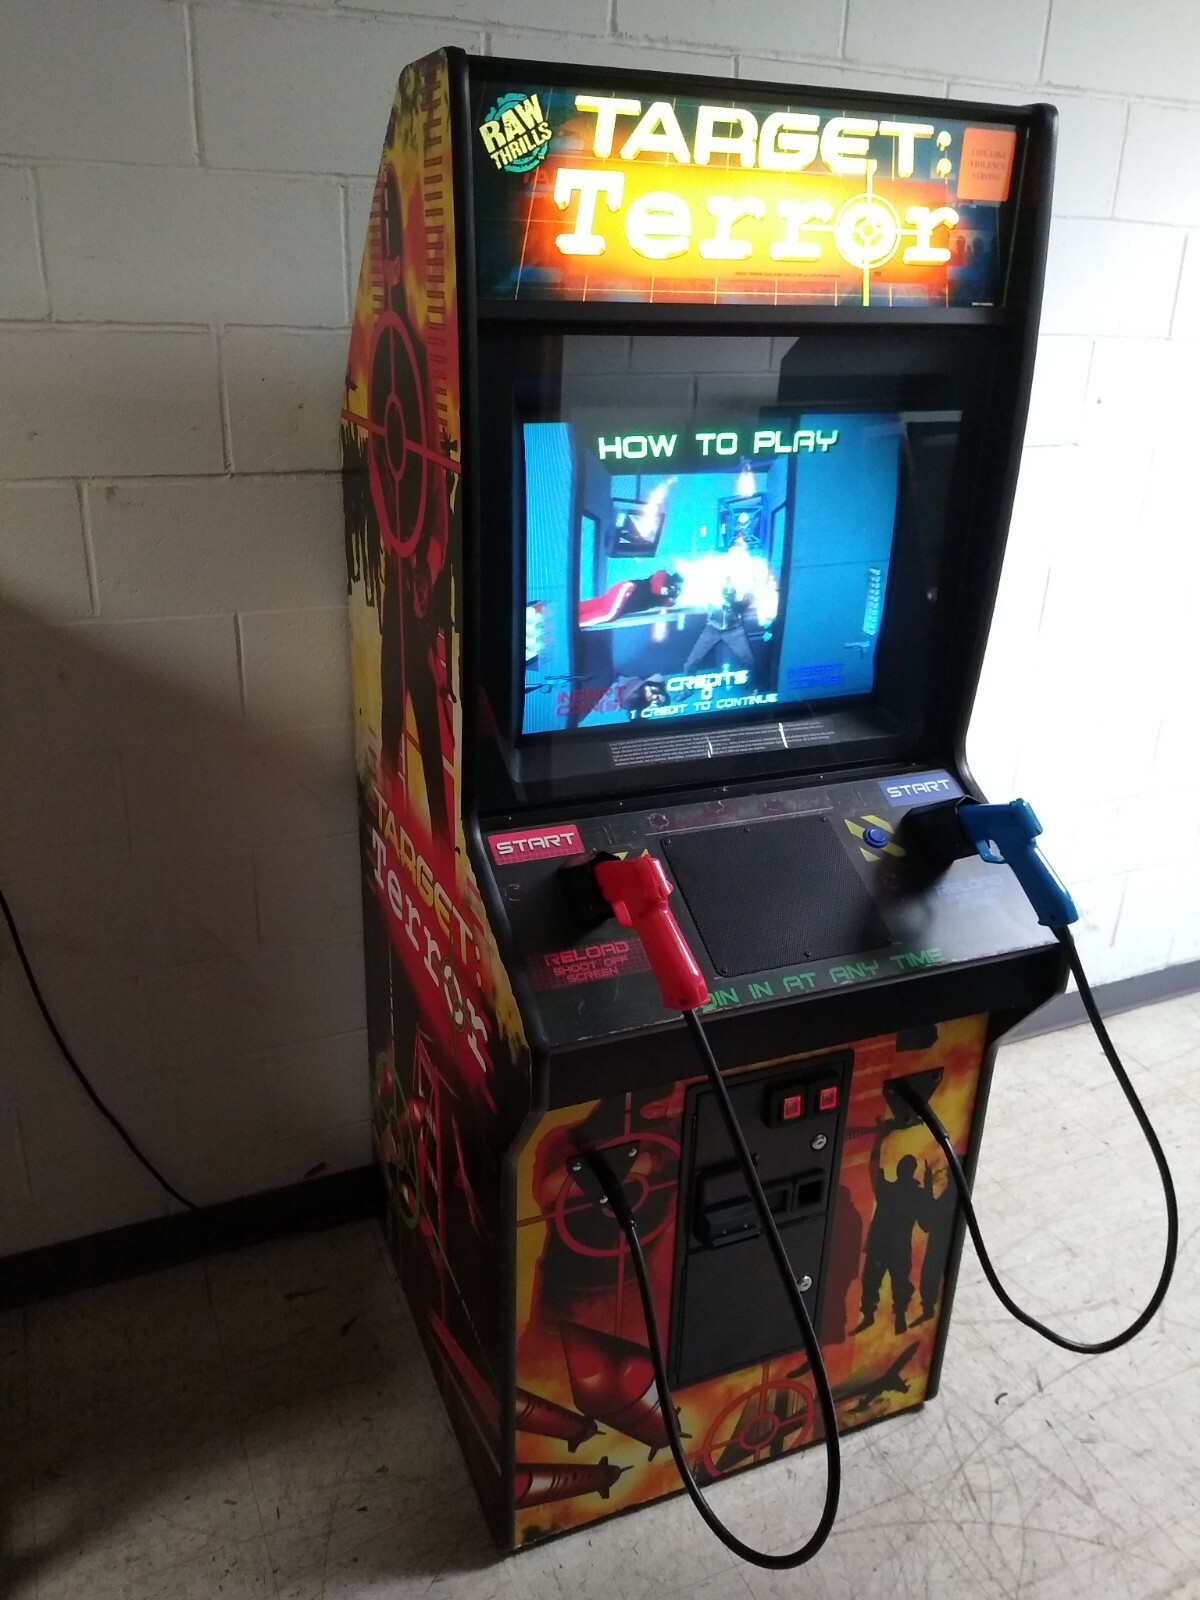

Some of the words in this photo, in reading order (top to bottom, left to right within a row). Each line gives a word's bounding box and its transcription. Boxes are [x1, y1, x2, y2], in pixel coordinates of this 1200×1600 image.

[479, 94, 543, 153] RAW
[575, 94, 952, 178] TARGET:
[490, 122, 552, 169] THRILLS
[970, 160, 1006, 170] VIOLENCE
[554, 168, 960, 267] Terror
[598, 434, 677, 459] HOW
[696, 432, 738, 455] TO
[753, 430, 838, 453] PLAY
[667, 670, 748, 692] CREDITS
[641, 703, 687, 719] CREDIT
[694, 698, 711, 711] TO
[716, 693, 778, 709] CONTINUE
[886, 779, 949, 798] START
[496, 832, 575, 855] START
[371, 827, 487, 1073] Terror
[544, 941, 630, 966] RELOAD
[553, 961, 597, 976] SHOOT
[604, 956, 628, 967] OFF
[566, 967, 619, 983] SCREEN
[749, 982, 773, 999] IN
[783, 972, 816, 992] AT
[828, 960, 879, 983] ANY
[889, 948, 946, 970] TIME
